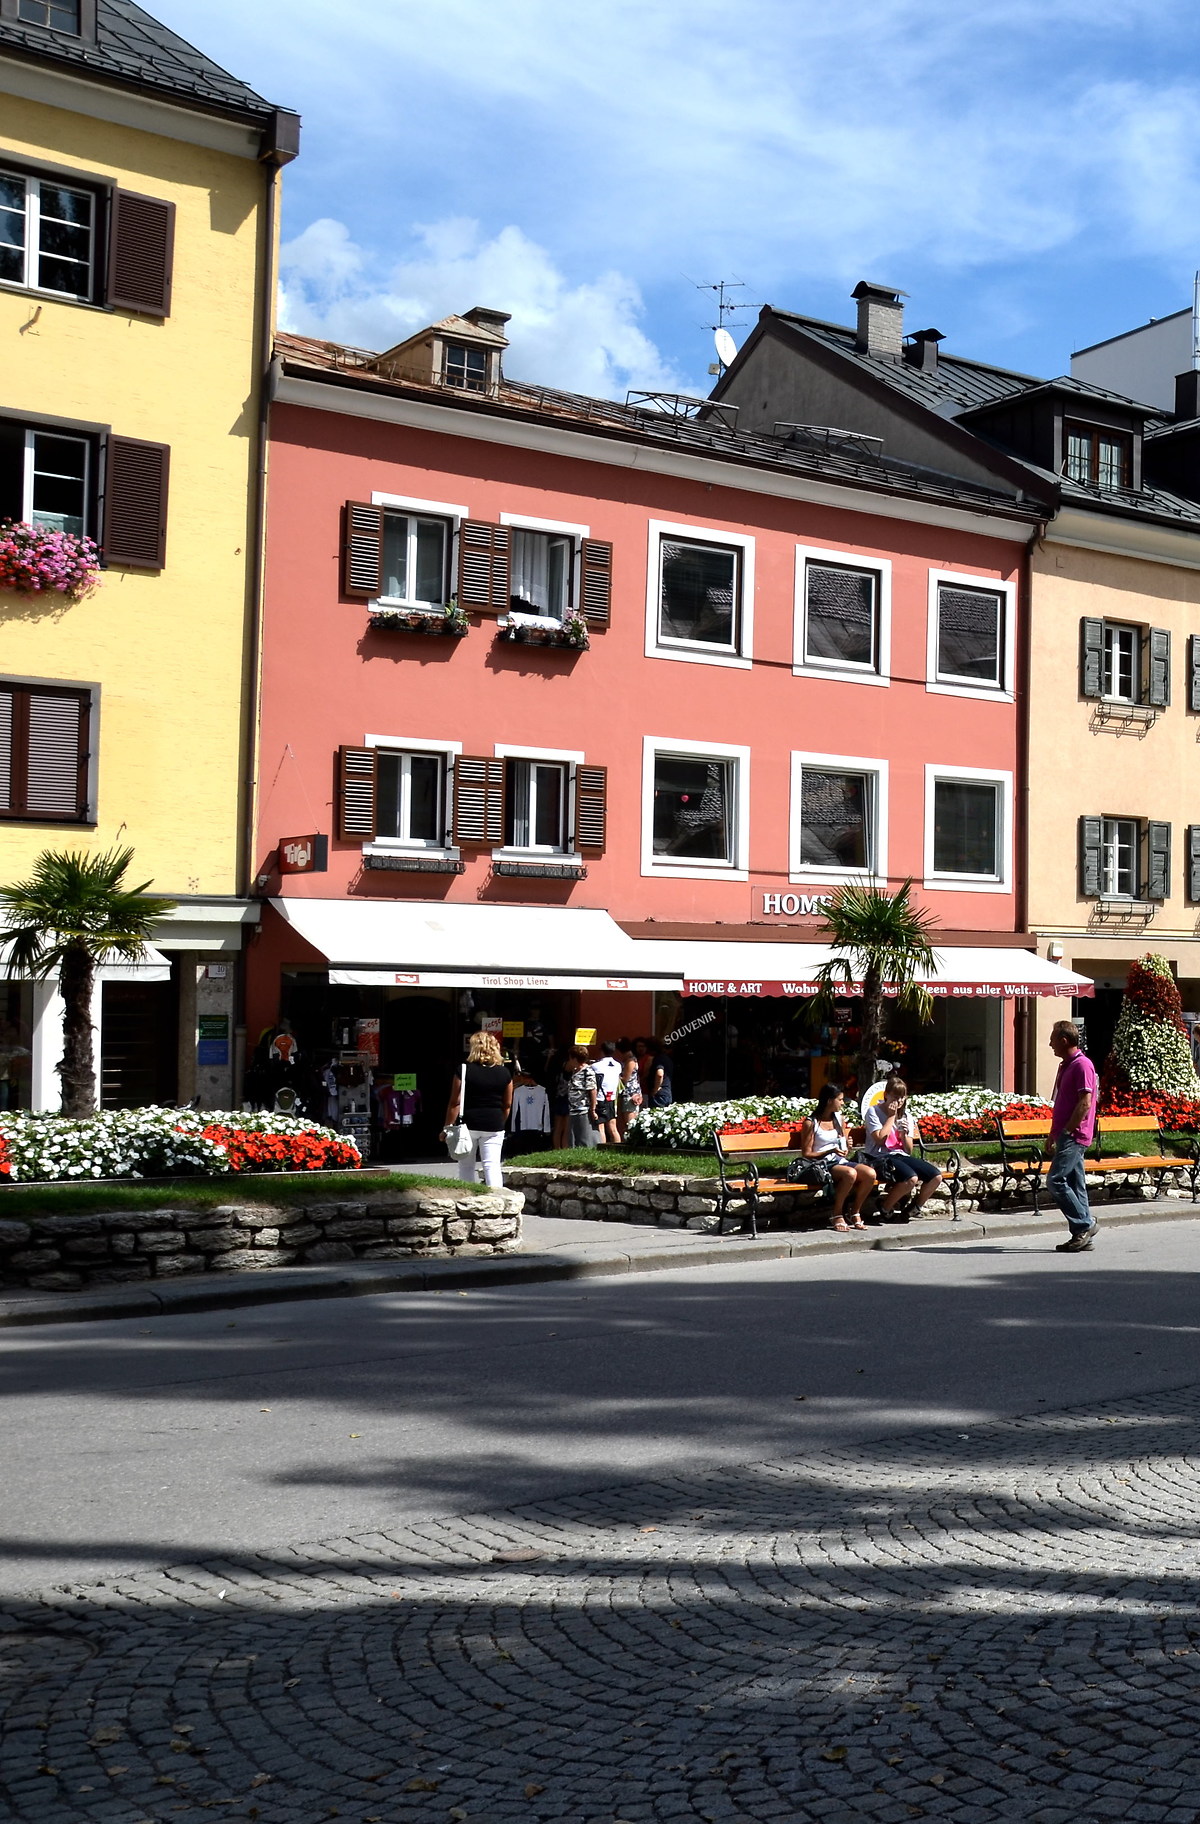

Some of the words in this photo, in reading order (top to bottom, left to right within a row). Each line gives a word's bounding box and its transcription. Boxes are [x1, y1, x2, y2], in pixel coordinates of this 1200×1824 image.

[284, 842, 311, 867] Tirol
[482, 977, 501, 985] Tirol
[504, 977, 523, 987] Shop
[526, 977, 549, 986] Lienz
[689, 982, 724, 993] HOME
[727, 983, 737, 993] &
[739, 983, 762, 994] ART
[782, 983, 819, 994] Wohn
[953, 985, 973, 994] aus
[976, 984, 1000, 995] aller
[664, 1011, 716, 1045] SOUVENIR
